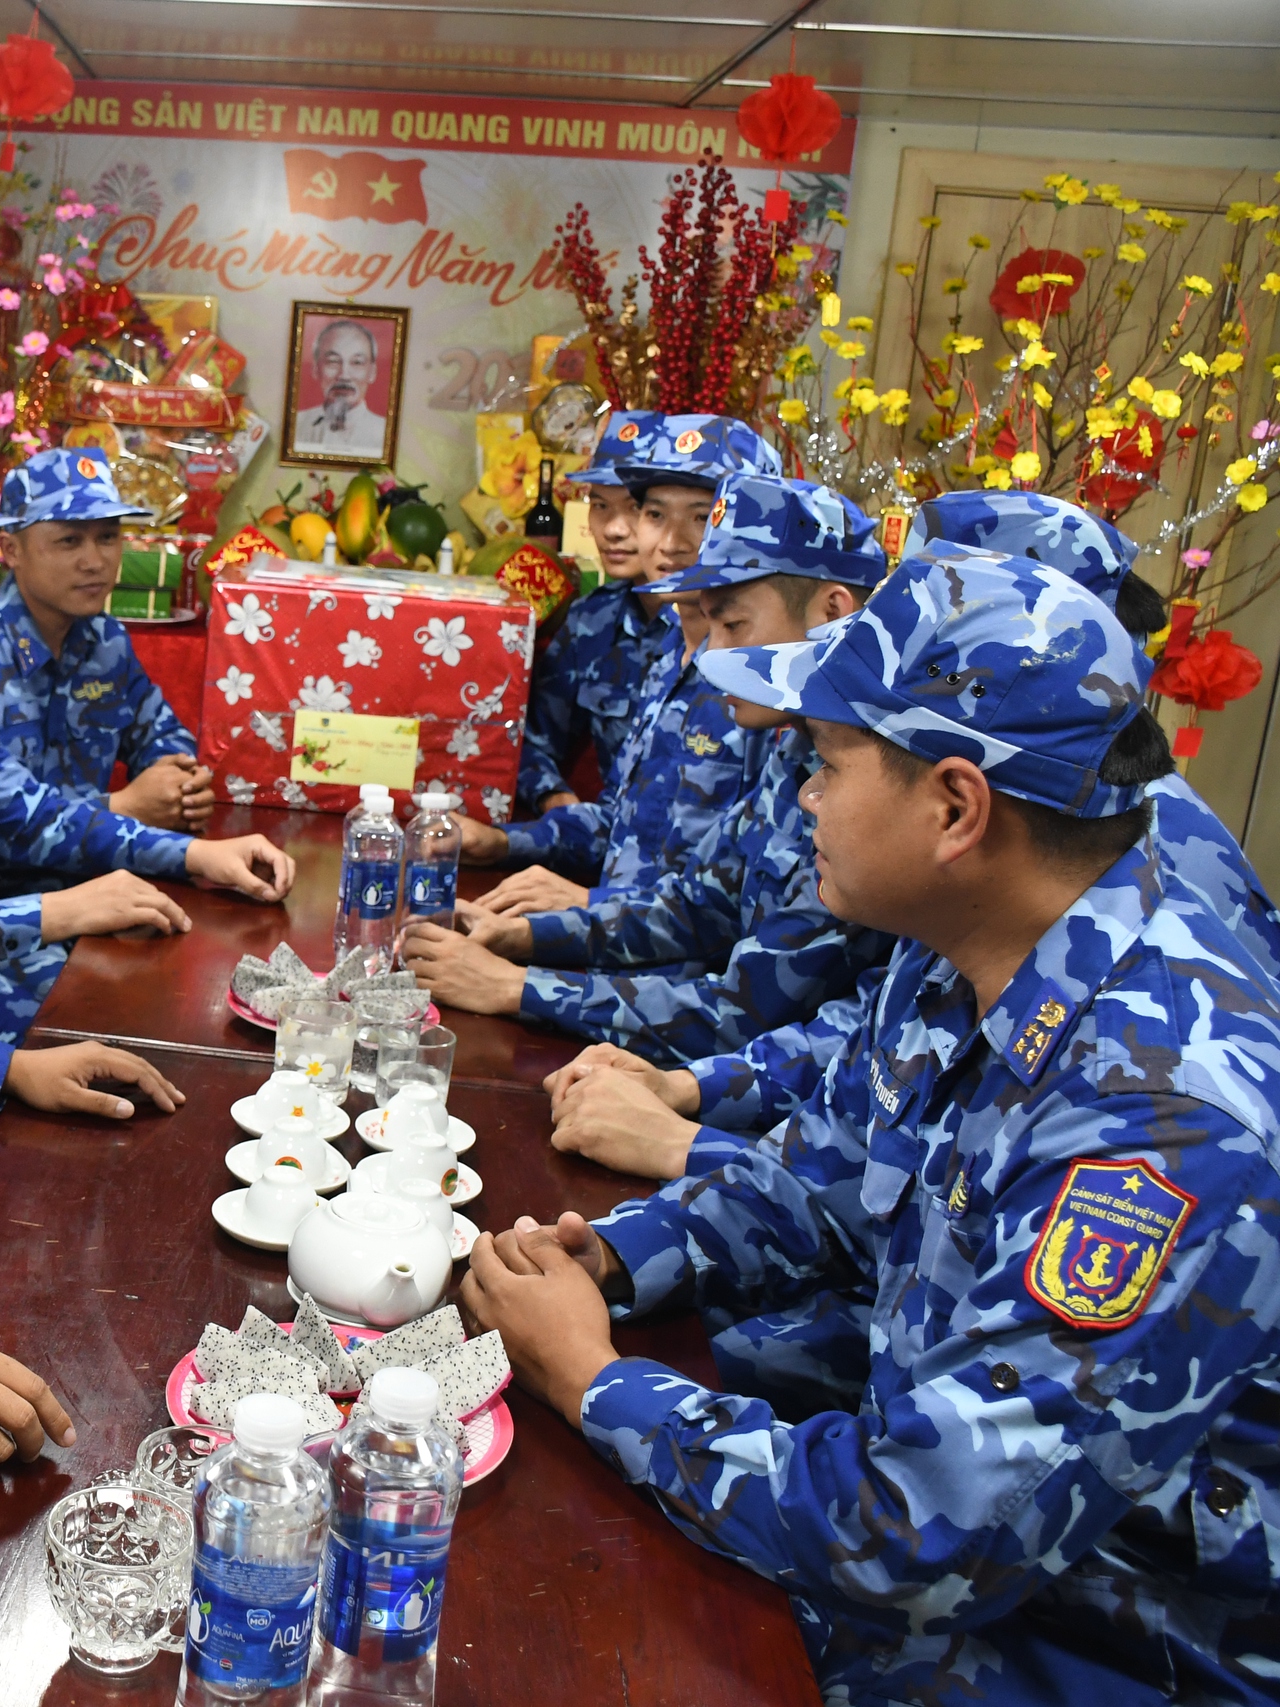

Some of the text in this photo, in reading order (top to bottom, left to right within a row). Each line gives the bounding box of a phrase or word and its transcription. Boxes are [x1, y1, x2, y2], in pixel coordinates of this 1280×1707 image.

[131, 90, 203, 129] SẢN
[214, 98, 287, 138] VIỆT
[297, 106, 380, 137] NAM
[391, 110, 510, 144] QUANG
[522, 116, 606, 149] VINH
[617, 120, 727, 156] MUÔN
[89, 203, 271, 292] Chúc
[248, 229, 393, 296] Mừng
[384, 228, 526, 307] Năm
[1069, 1201, 1163, 1239] VIETNAM COAST GUARD
[1070, 1186, 1174, 1228] CẢNH SÁT BIỂN VIỆT NAM
[211, 1624, 245, 1642] AQUAFINA
